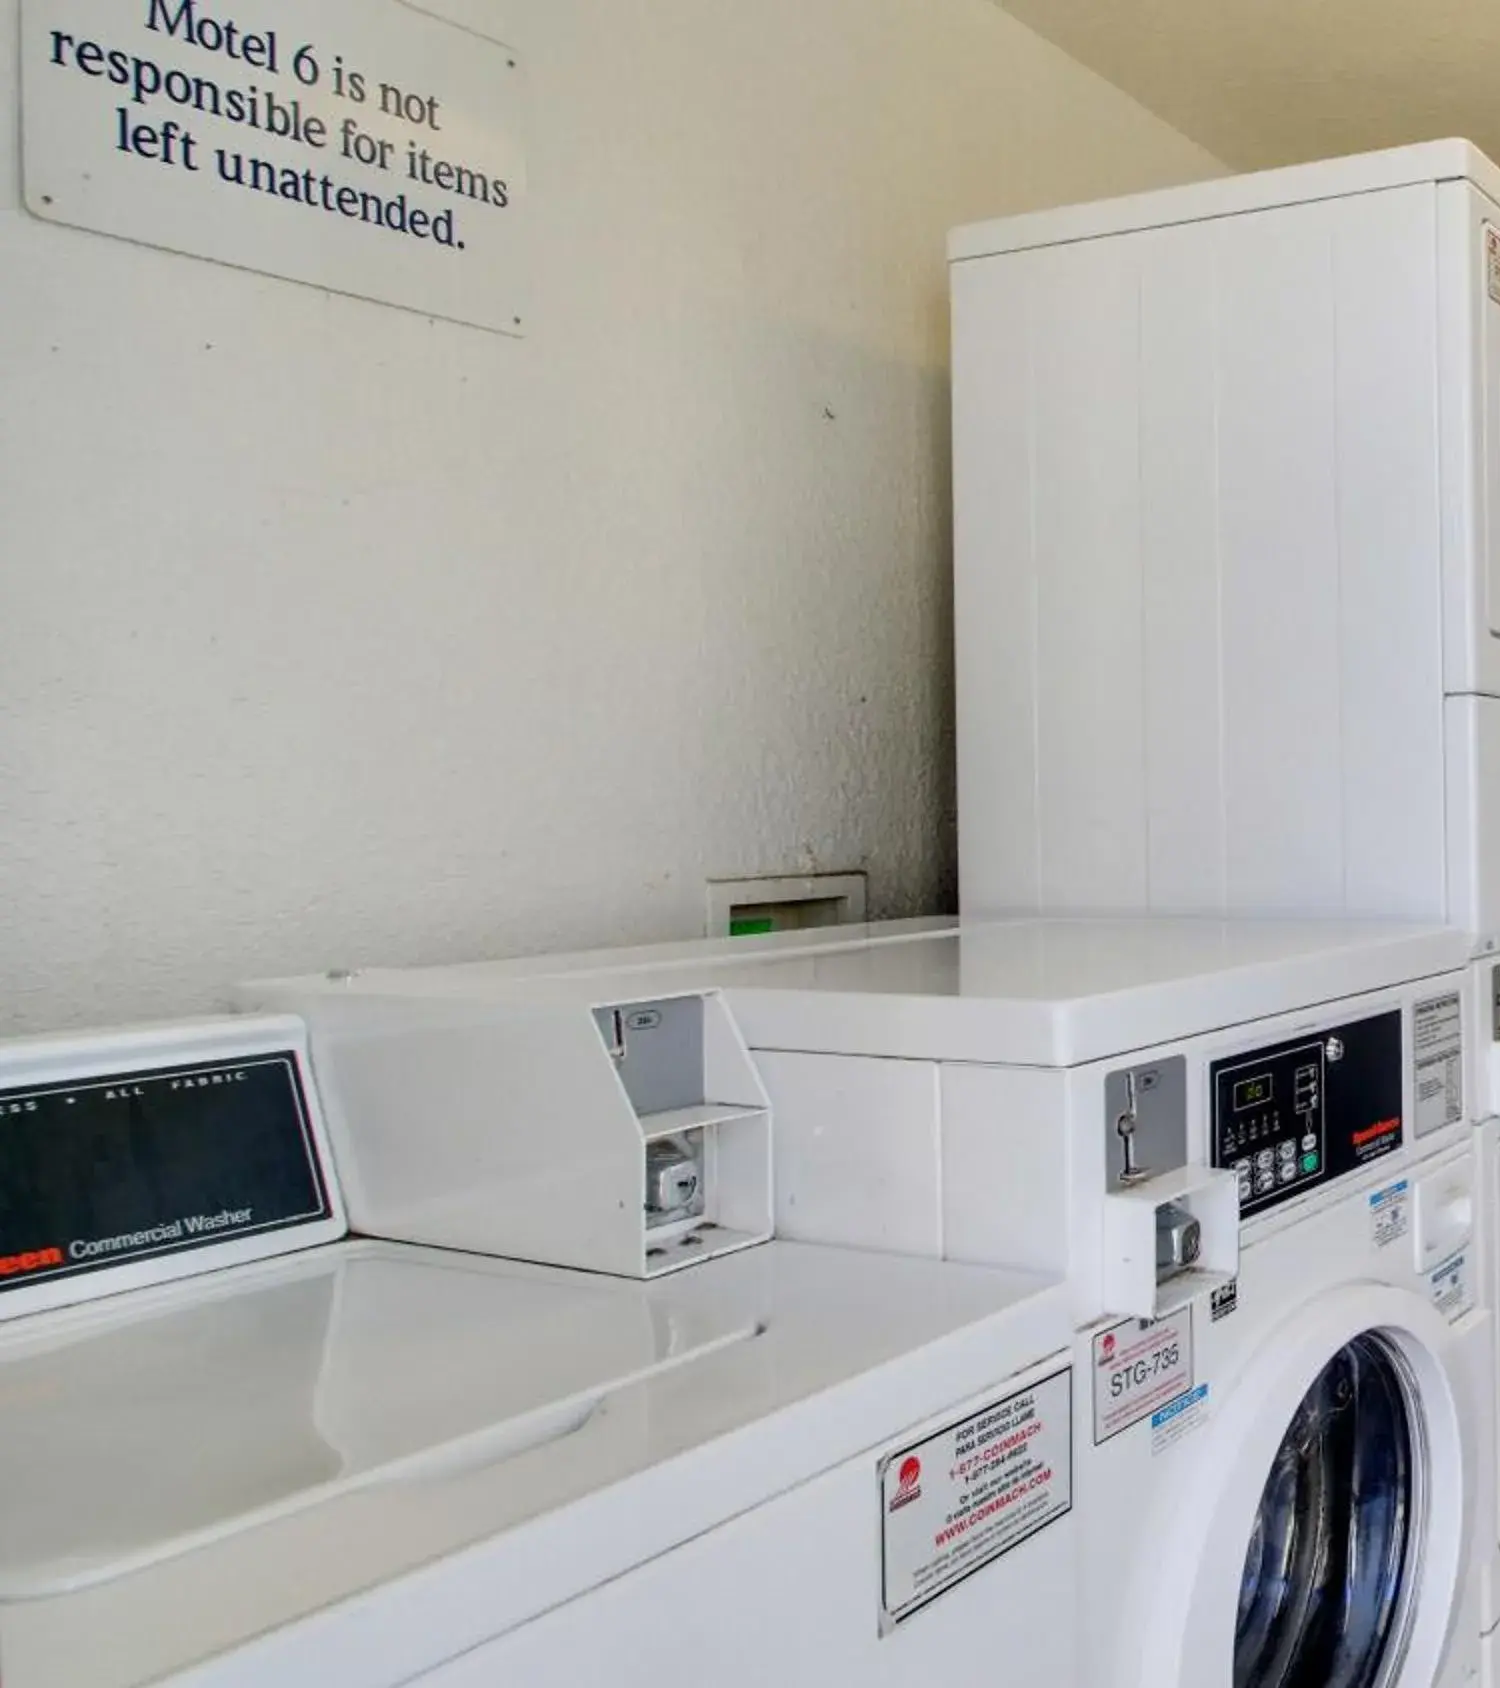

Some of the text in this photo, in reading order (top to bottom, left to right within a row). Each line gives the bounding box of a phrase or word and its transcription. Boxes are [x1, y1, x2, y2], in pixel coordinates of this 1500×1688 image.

[146, 0, 442, 131] Motel 6 is not
[51, 30, 509, 207] responsible for items
[116, 108, 466, 250] left unattended.
[105, 1087, 144, 1099] ALL
[171, 1071, 247, 1090] FABRIC
[70, 1222, 182, 1258] Commercial
[184, 1207, 252, 1233] Washer
[1111, 1344, 1180, 1397] STG-735
[956, 1395, 1034, 1441] FOR SERVICE CALL
